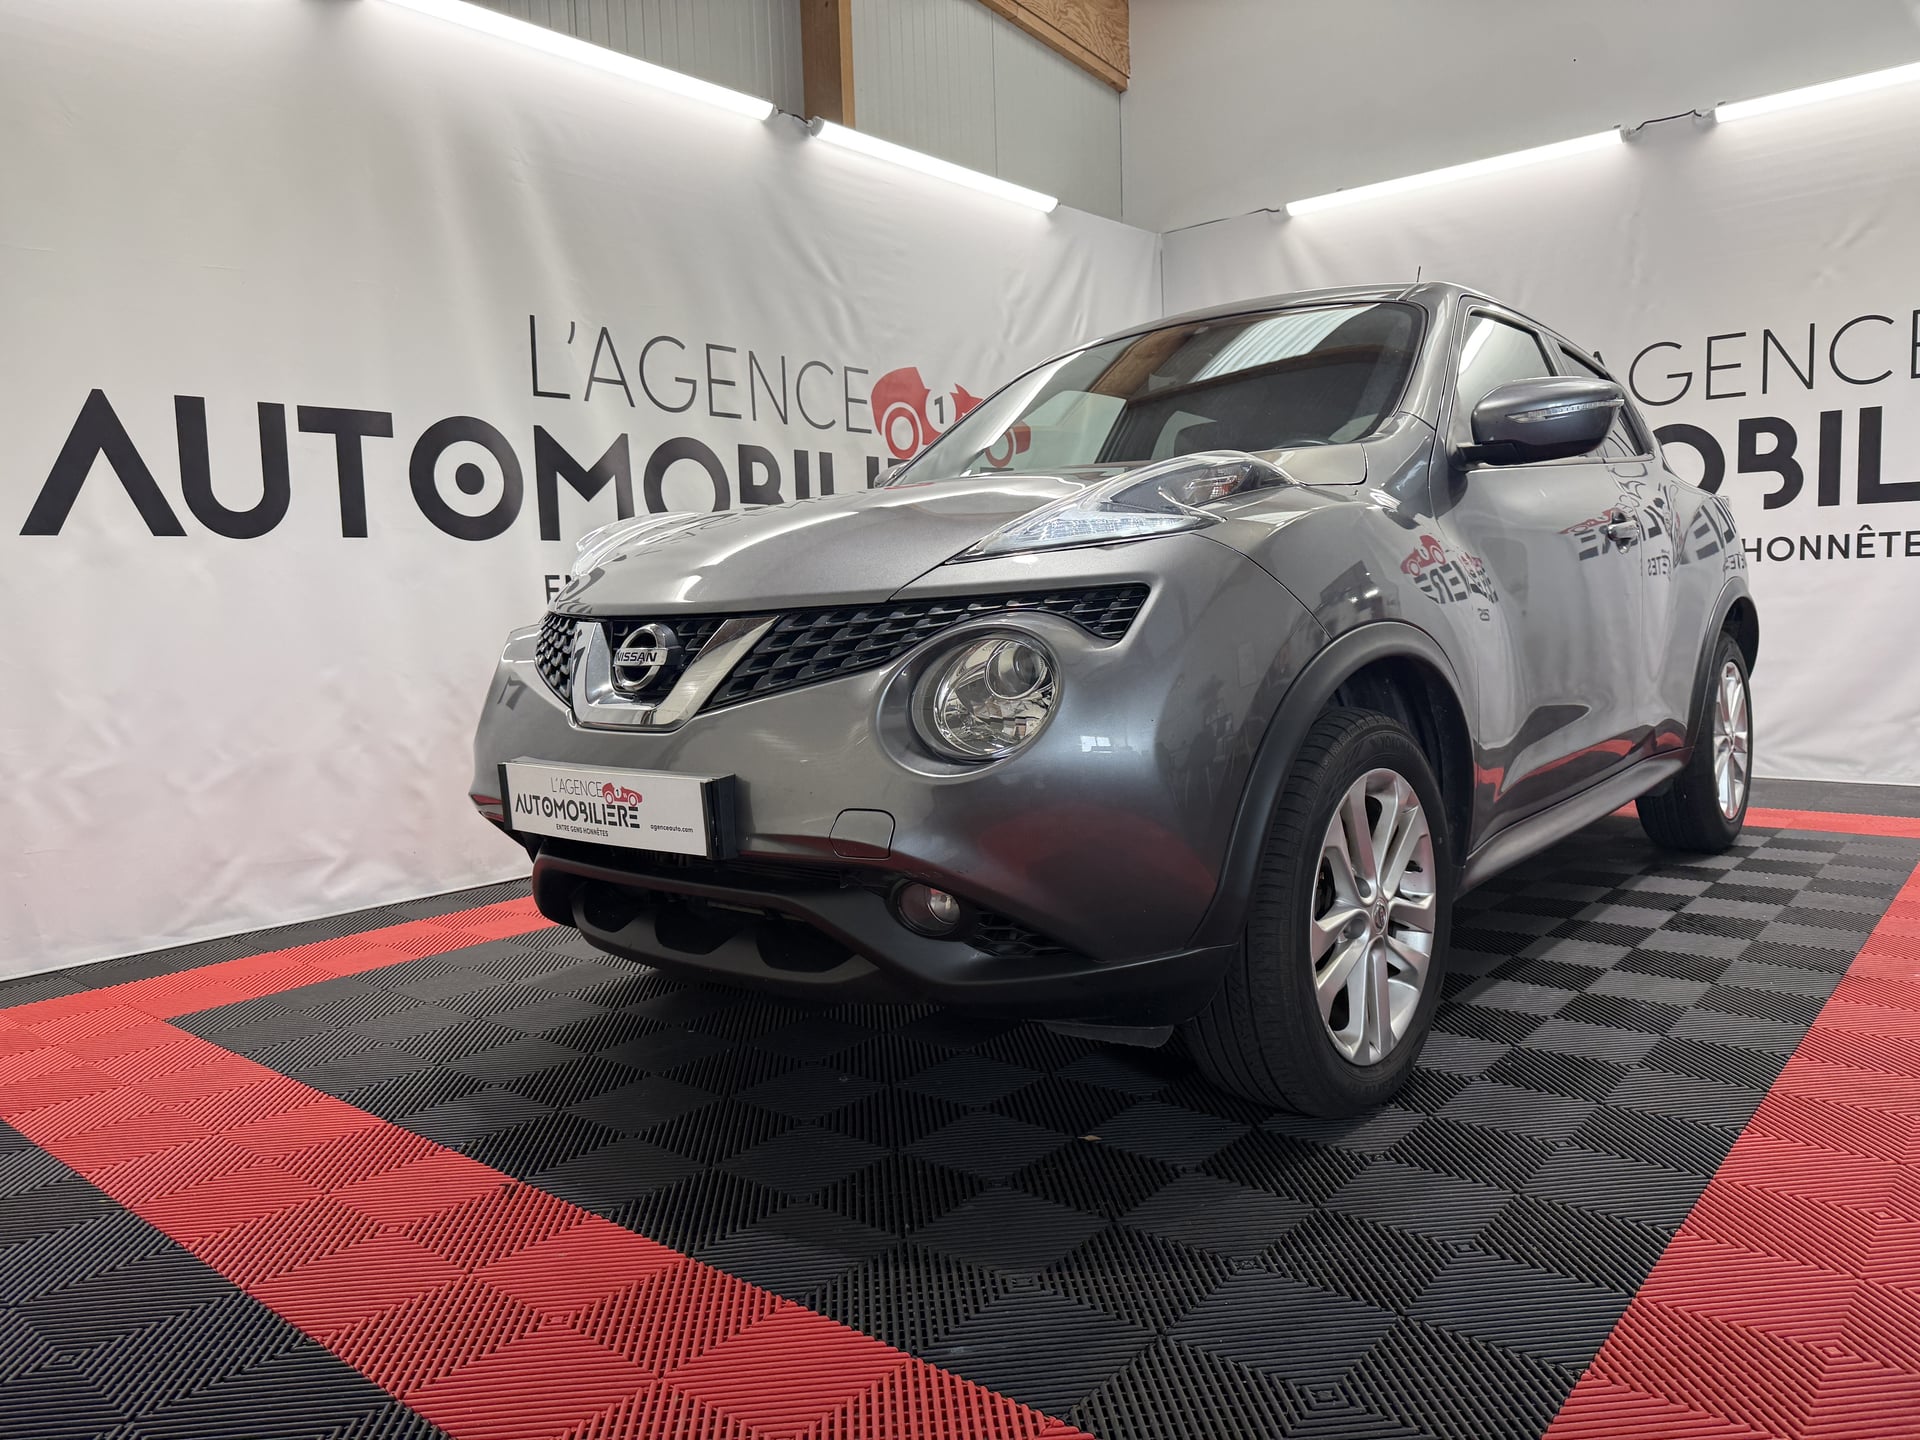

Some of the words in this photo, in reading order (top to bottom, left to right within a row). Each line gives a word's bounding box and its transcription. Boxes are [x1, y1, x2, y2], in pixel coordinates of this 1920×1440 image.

[529, 314, 873, 435] L'AGENCE
[934, 395, 945, 425] 1
[615, 651, 658, 663] NISSAN
[551, 776, 604, 798] L'AGENCE
[515, 793, 641, 829] AUTOMOBILIERE
